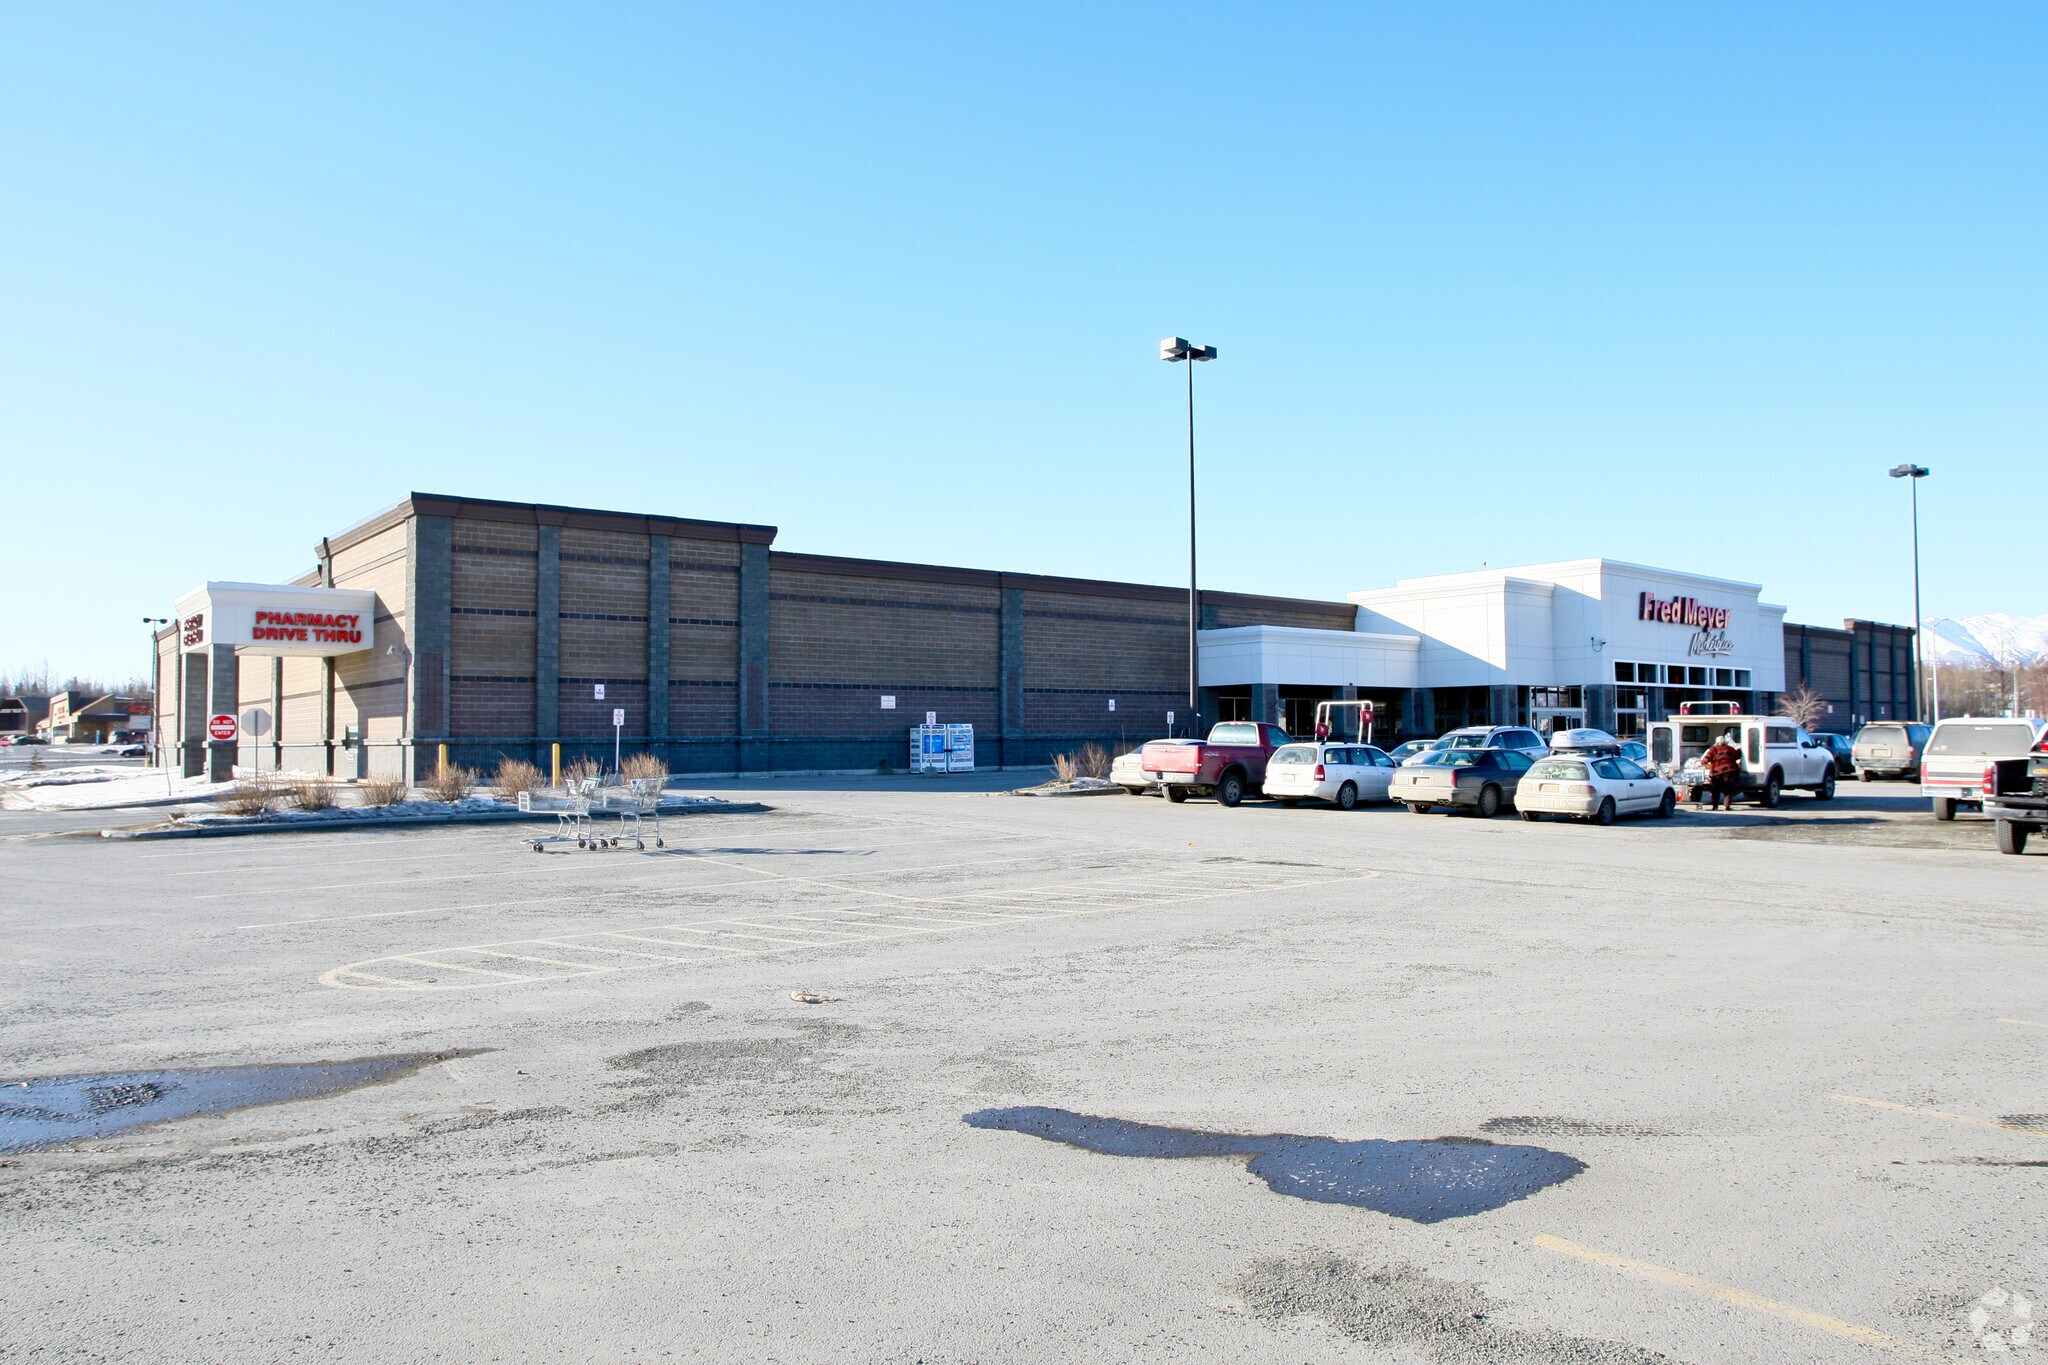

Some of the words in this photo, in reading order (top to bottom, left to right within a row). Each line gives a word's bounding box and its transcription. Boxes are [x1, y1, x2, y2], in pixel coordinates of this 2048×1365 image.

[255, 611, 359, 628] PHARMACY
[1640, 592, 1682, 623] Fred
[1684, 597, 1731, 632] Meyer
[252, 627, 308, 641] DRIVE
[313, 629, 362, 643] THRU
